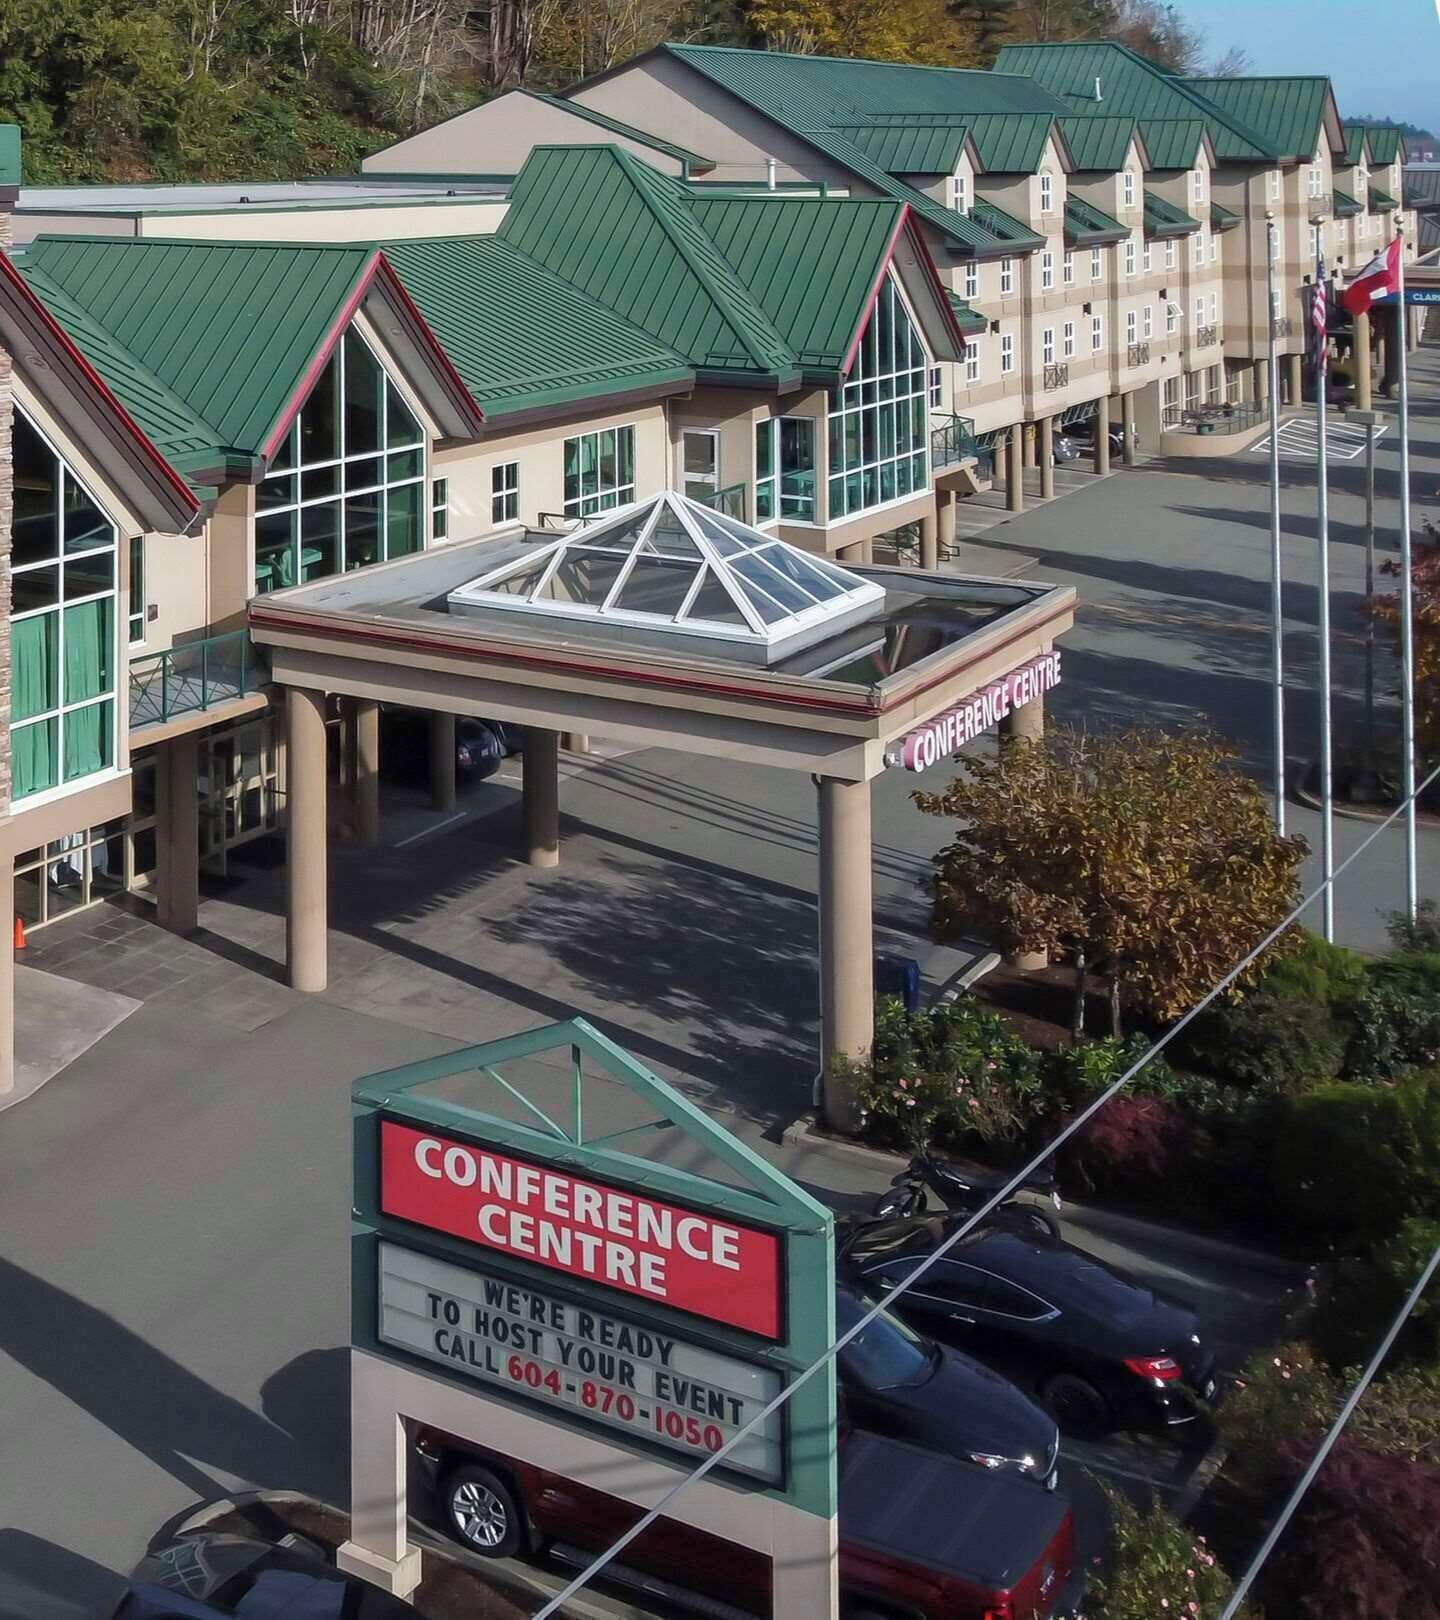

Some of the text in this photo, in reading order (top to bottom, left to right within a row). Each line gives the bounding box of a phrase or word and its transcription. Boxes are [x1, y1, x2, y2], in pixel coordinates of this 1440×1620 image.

[913, 651, 1061, 773] CONFERENCE CENTRE
[415, 1139, 740, 1271] CONFERENCE
[479, 1204, 667, 1297] CENTRE
[428, 1293, 743, 1425] TO HOST YOUR EVENT
[484, 1280, 674, 1367] WE'RE READY
[435, 1329, 723, 1452] CALL 604-870-1050
